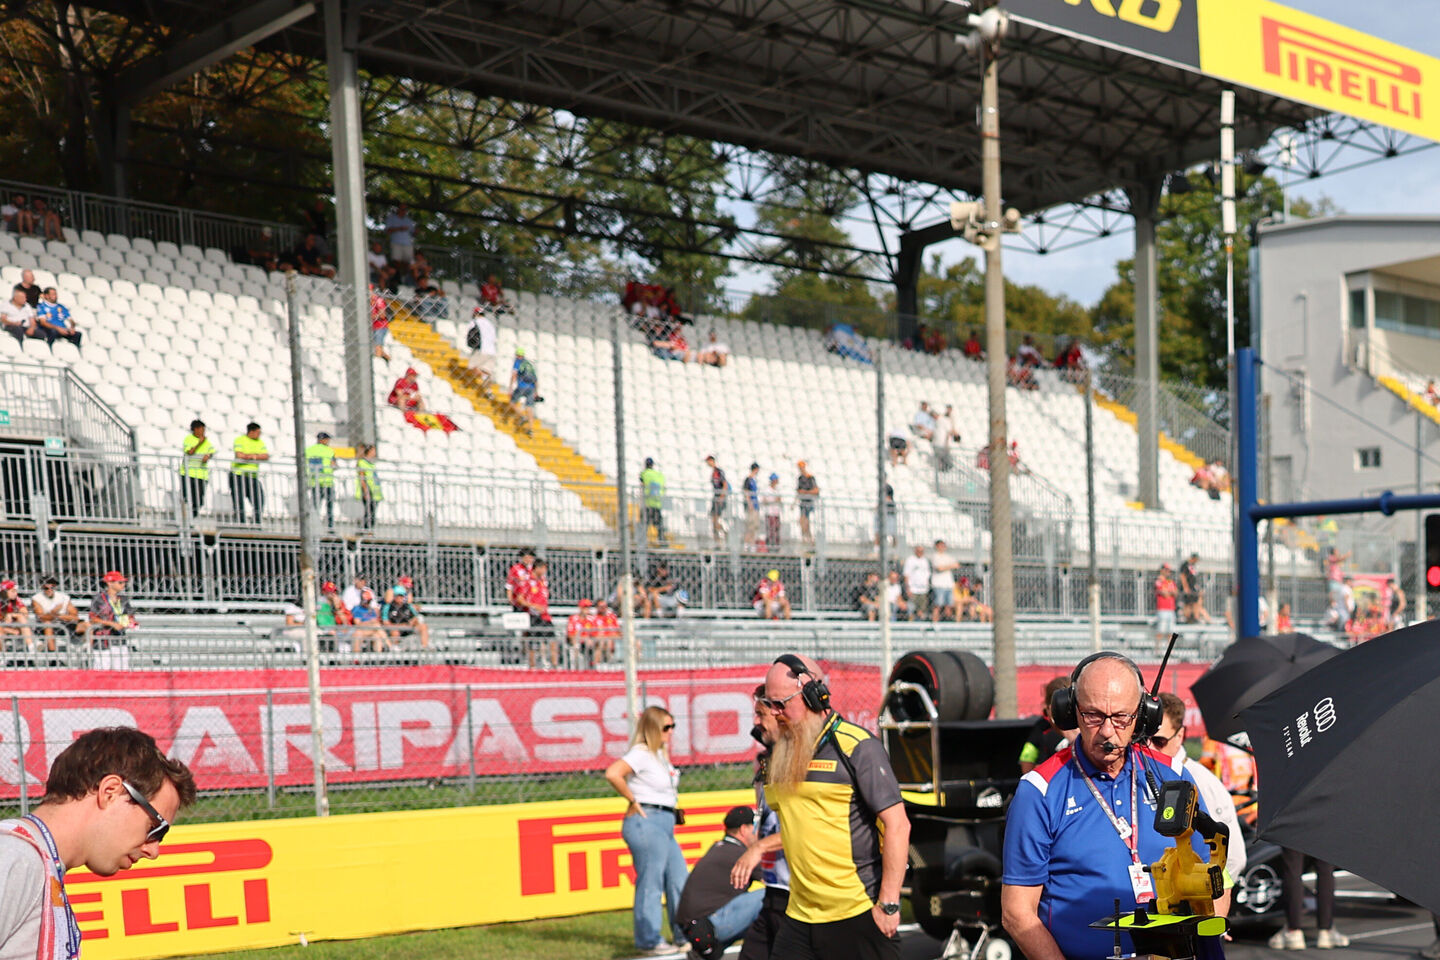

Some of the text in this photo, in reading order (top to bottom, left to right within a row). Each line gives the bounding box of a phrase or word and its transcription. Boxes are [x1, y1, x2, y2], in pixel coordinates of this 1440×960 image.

[1260, 16, 1423, 120] PIRELLI
[1285, 736, 1294, 758] TEAM
[1296, 711, 1313, 748] Revolut
